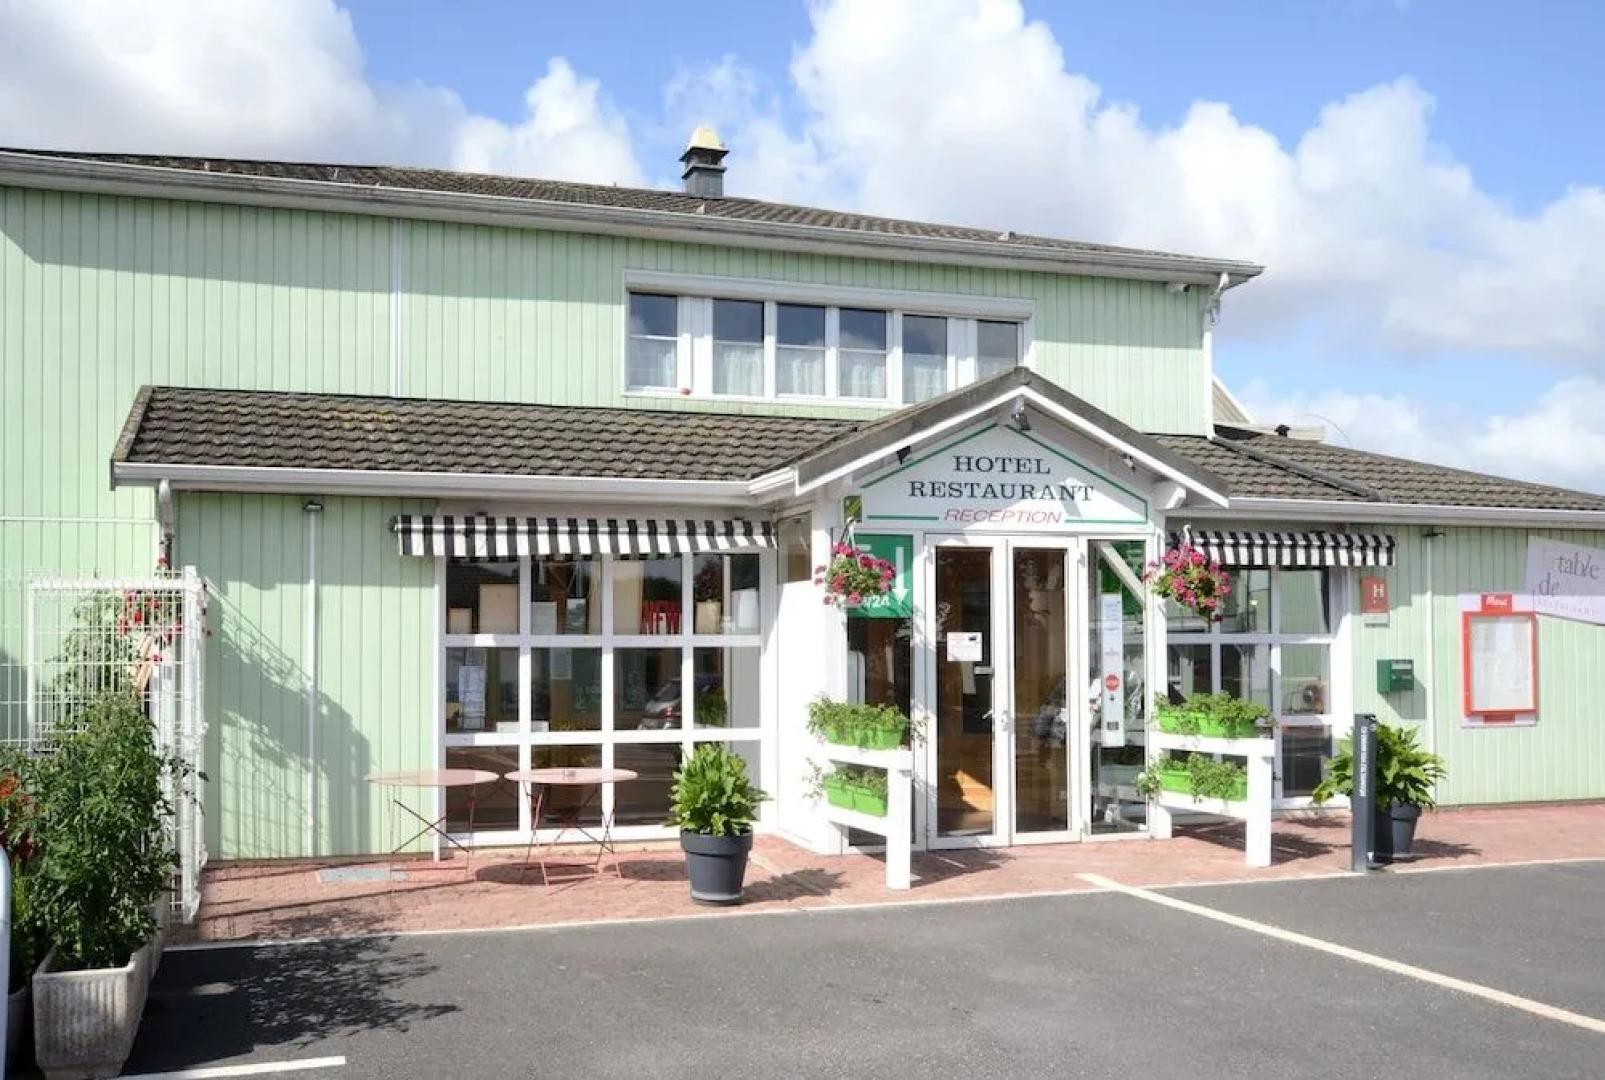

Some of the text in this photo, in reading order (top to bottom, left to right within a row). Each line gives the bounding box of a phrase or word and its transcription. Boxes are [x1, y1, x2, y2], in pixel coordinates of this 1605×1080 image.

[953, 456, 1050, 474] HOTEL
[908, 481, 1094, 502] RESTAURANT
[943, 508, 1064, 524] RECEPTION
[1558, 552, 1601, 580] table
[1373, 583, 1385, 598] H
